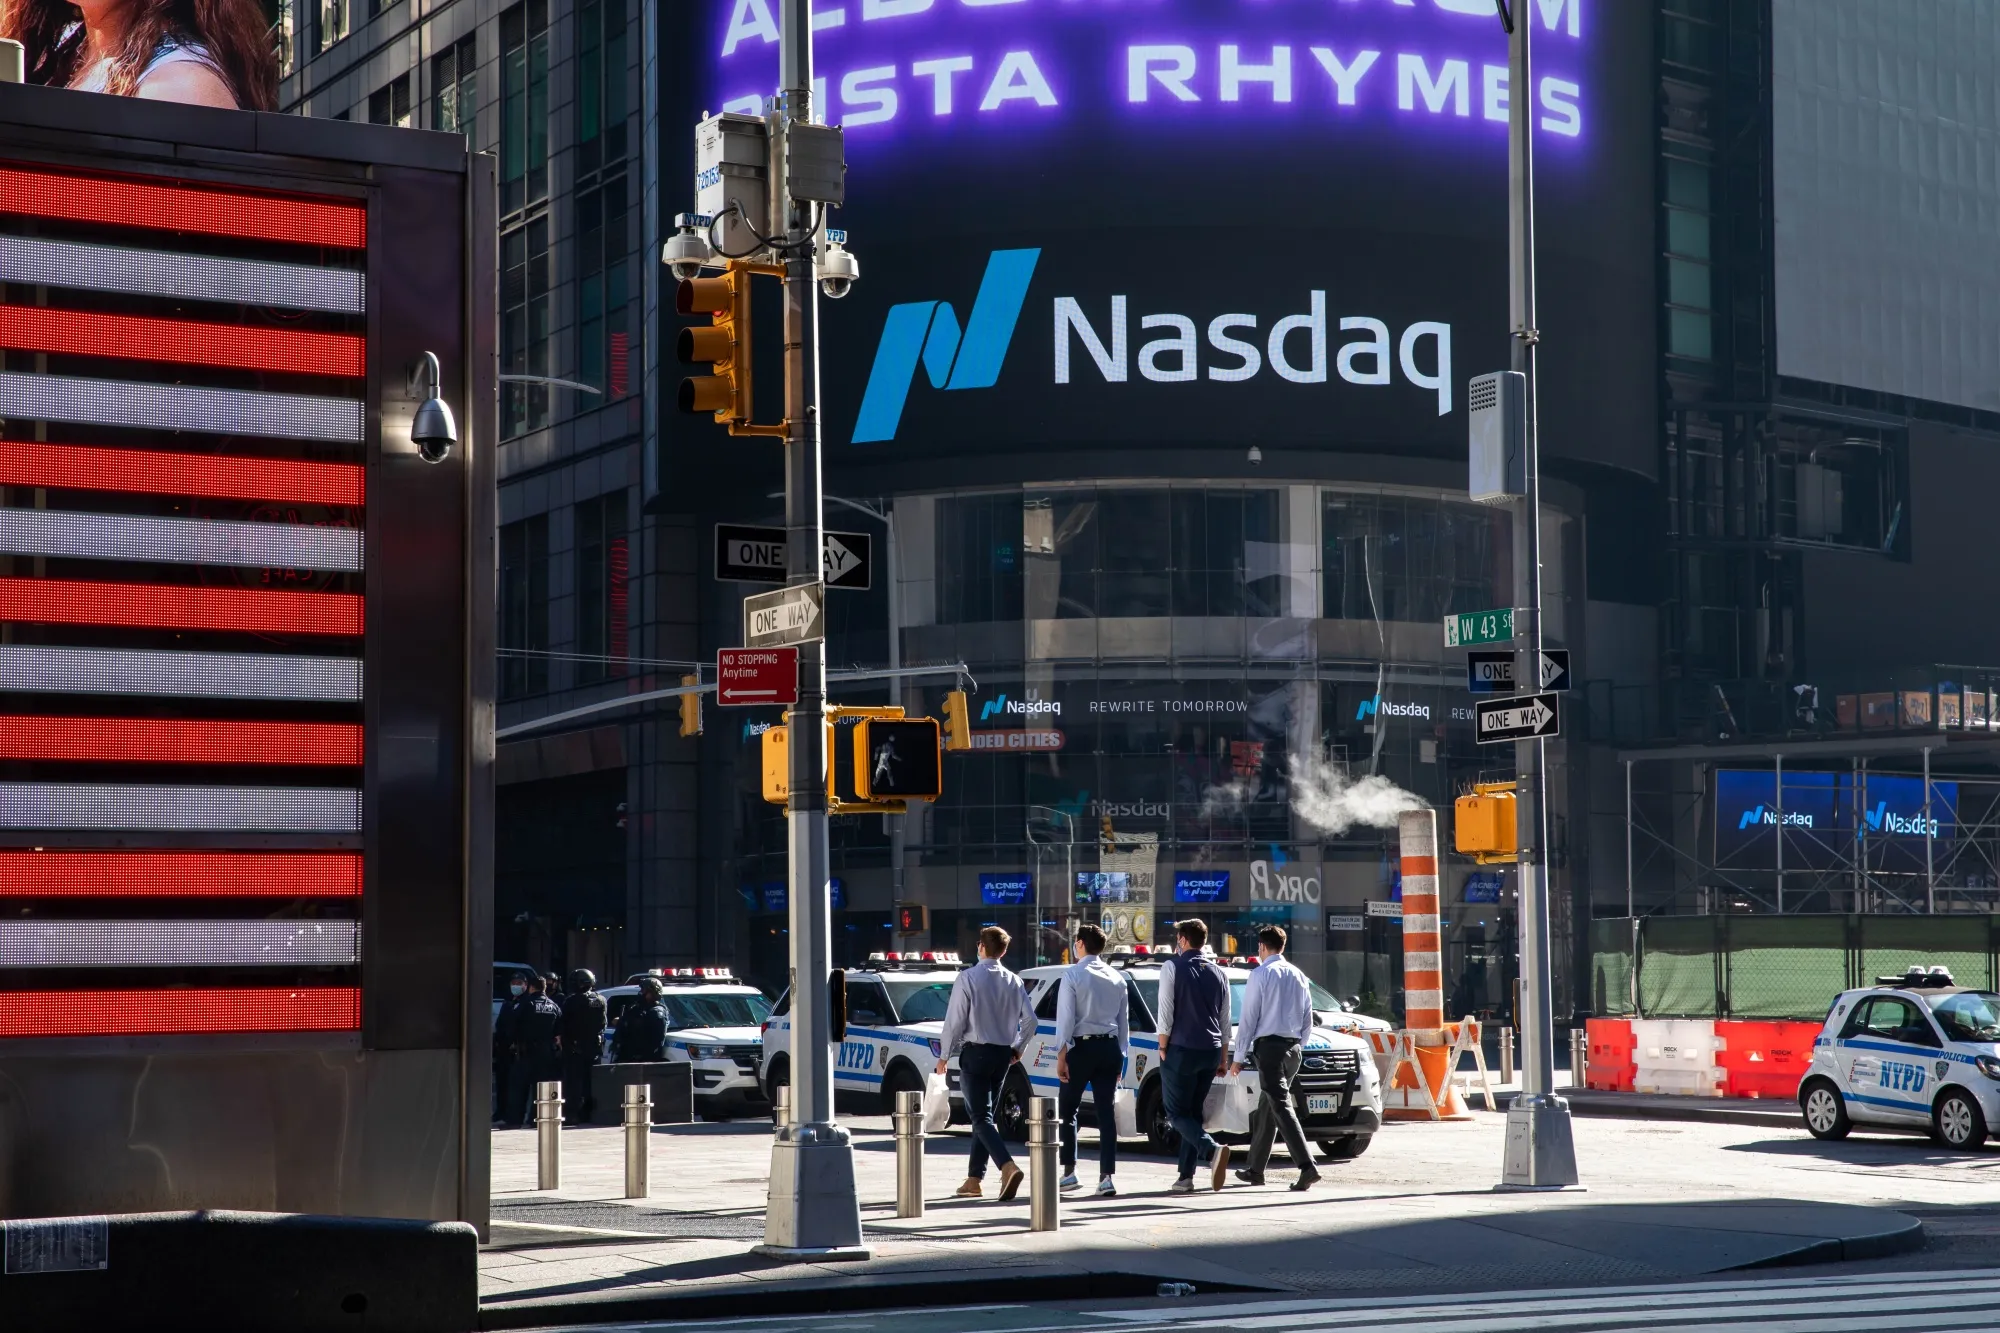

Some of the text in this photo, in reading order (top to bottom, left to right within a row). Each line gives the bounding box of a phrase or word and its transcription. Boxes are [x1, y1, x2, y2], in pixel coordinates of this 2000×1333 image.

[1128, 44, 1582, 137] RHYMES
[685, 214, 711, 226] NYPD
[826, 230, 845, 242] YPD
[1053, 290, 1452, 416] Nasdaq
[740, 543, 847, 570] ONE AY
[756, 602, 811, 633] ONE WAY
[1462, 613, 1512, 640] W 43 St
[722, 653, 778, 665] NO STOPPING
[722, 667, 758, 680] Anytime
[1483, 664, 1511, 679] ONE
[1007, 699, 1060, 716] Nasdaq
[1089, 700, 1248, 712] REWRITE TOMORROW
[1382, 702, 1430, 720] Nasdaq
[1487, 712, 1510, 729] ONE
[1520, 707, 1545, 726] WAY
[1008, 732, 1060, 748] CITIES
[1092, 798, 1170, 820] Nasdaq
[1885, 812, 1938, 839] Nasdaq
[838, 1041, 875, 1070] NYPD
[1939, 1050, 1966, 1063] POLICE
[1880, 1061, 1926, 1092] NYPD
[1310, 1100, 1329, 1108] 5108
